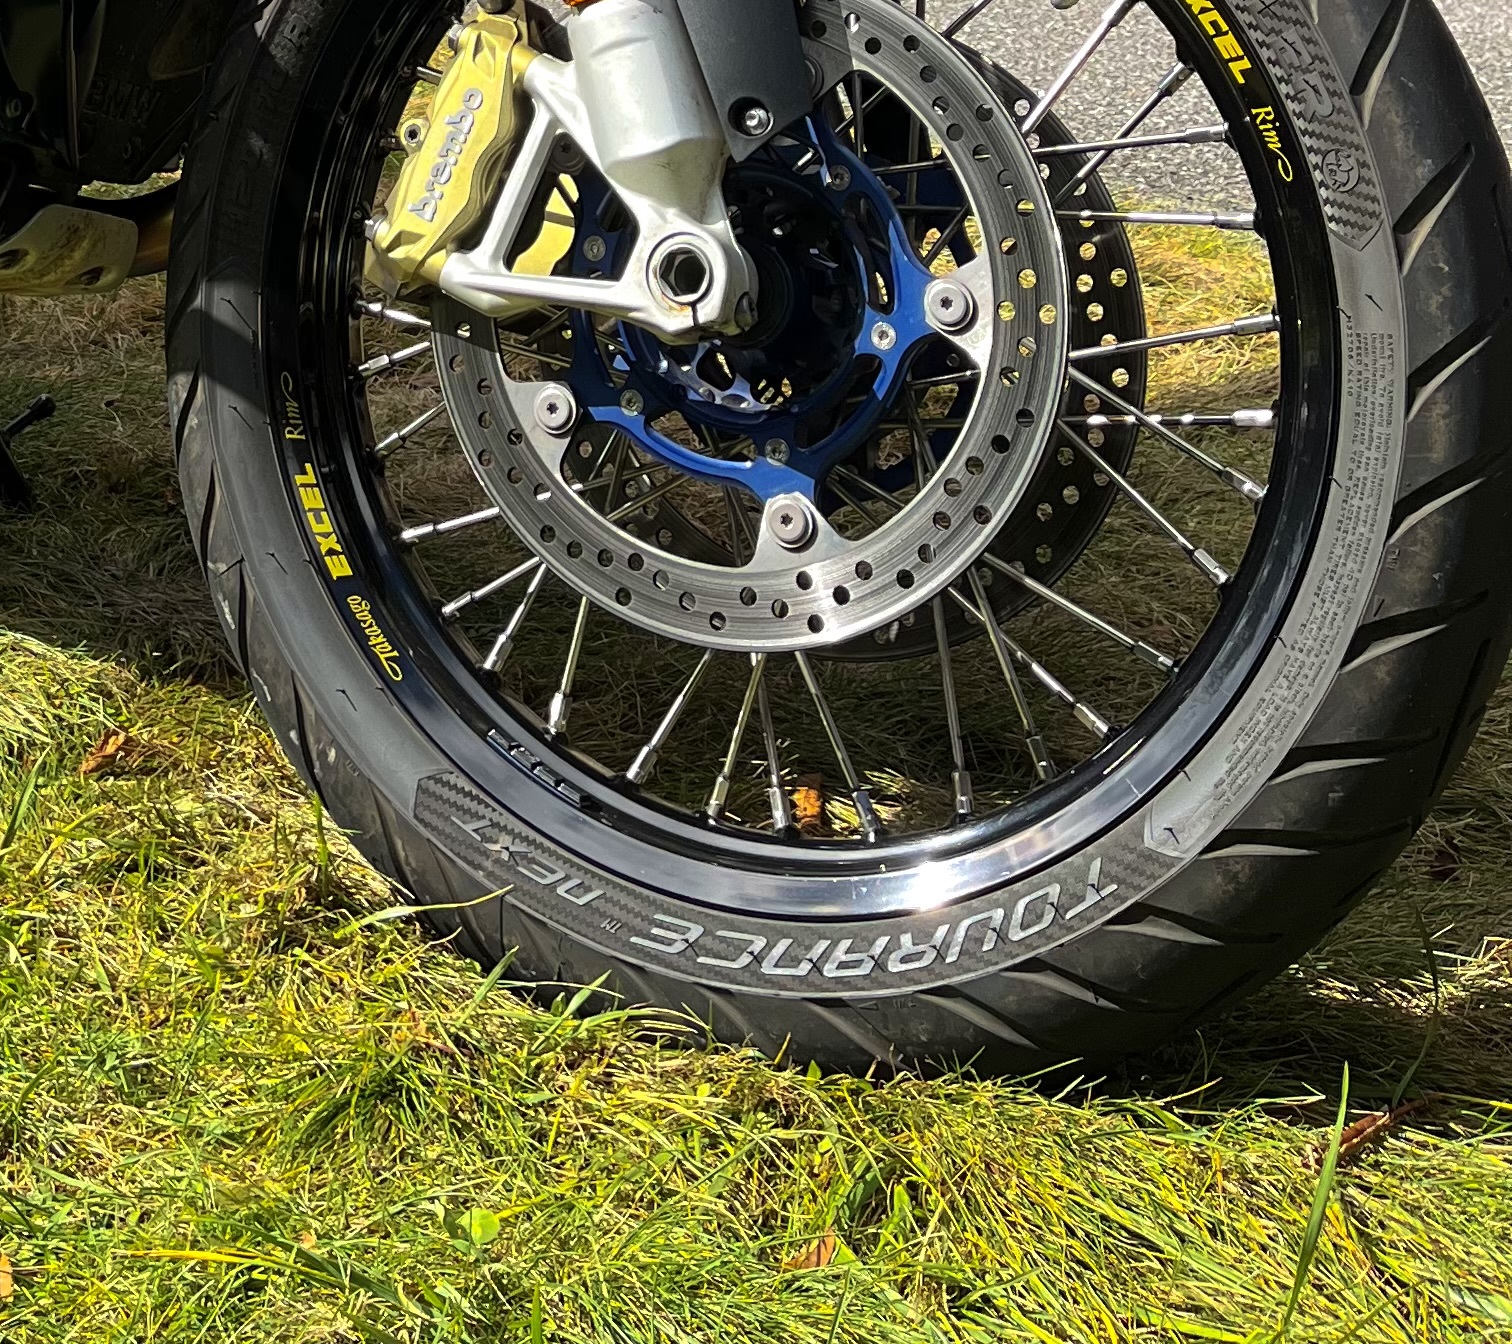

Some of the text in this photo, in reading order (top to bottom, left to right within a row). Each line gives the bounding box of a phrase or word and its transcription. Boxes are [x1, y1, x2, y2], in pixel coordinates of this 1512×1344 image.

[408, 87, 484, 223] brembo
[1241, 105, 1293, 182] Rim
[280, 371, 403, 682] Takasago EXCEL Rim
[629, 856, 1119, 979] TOURANCE
